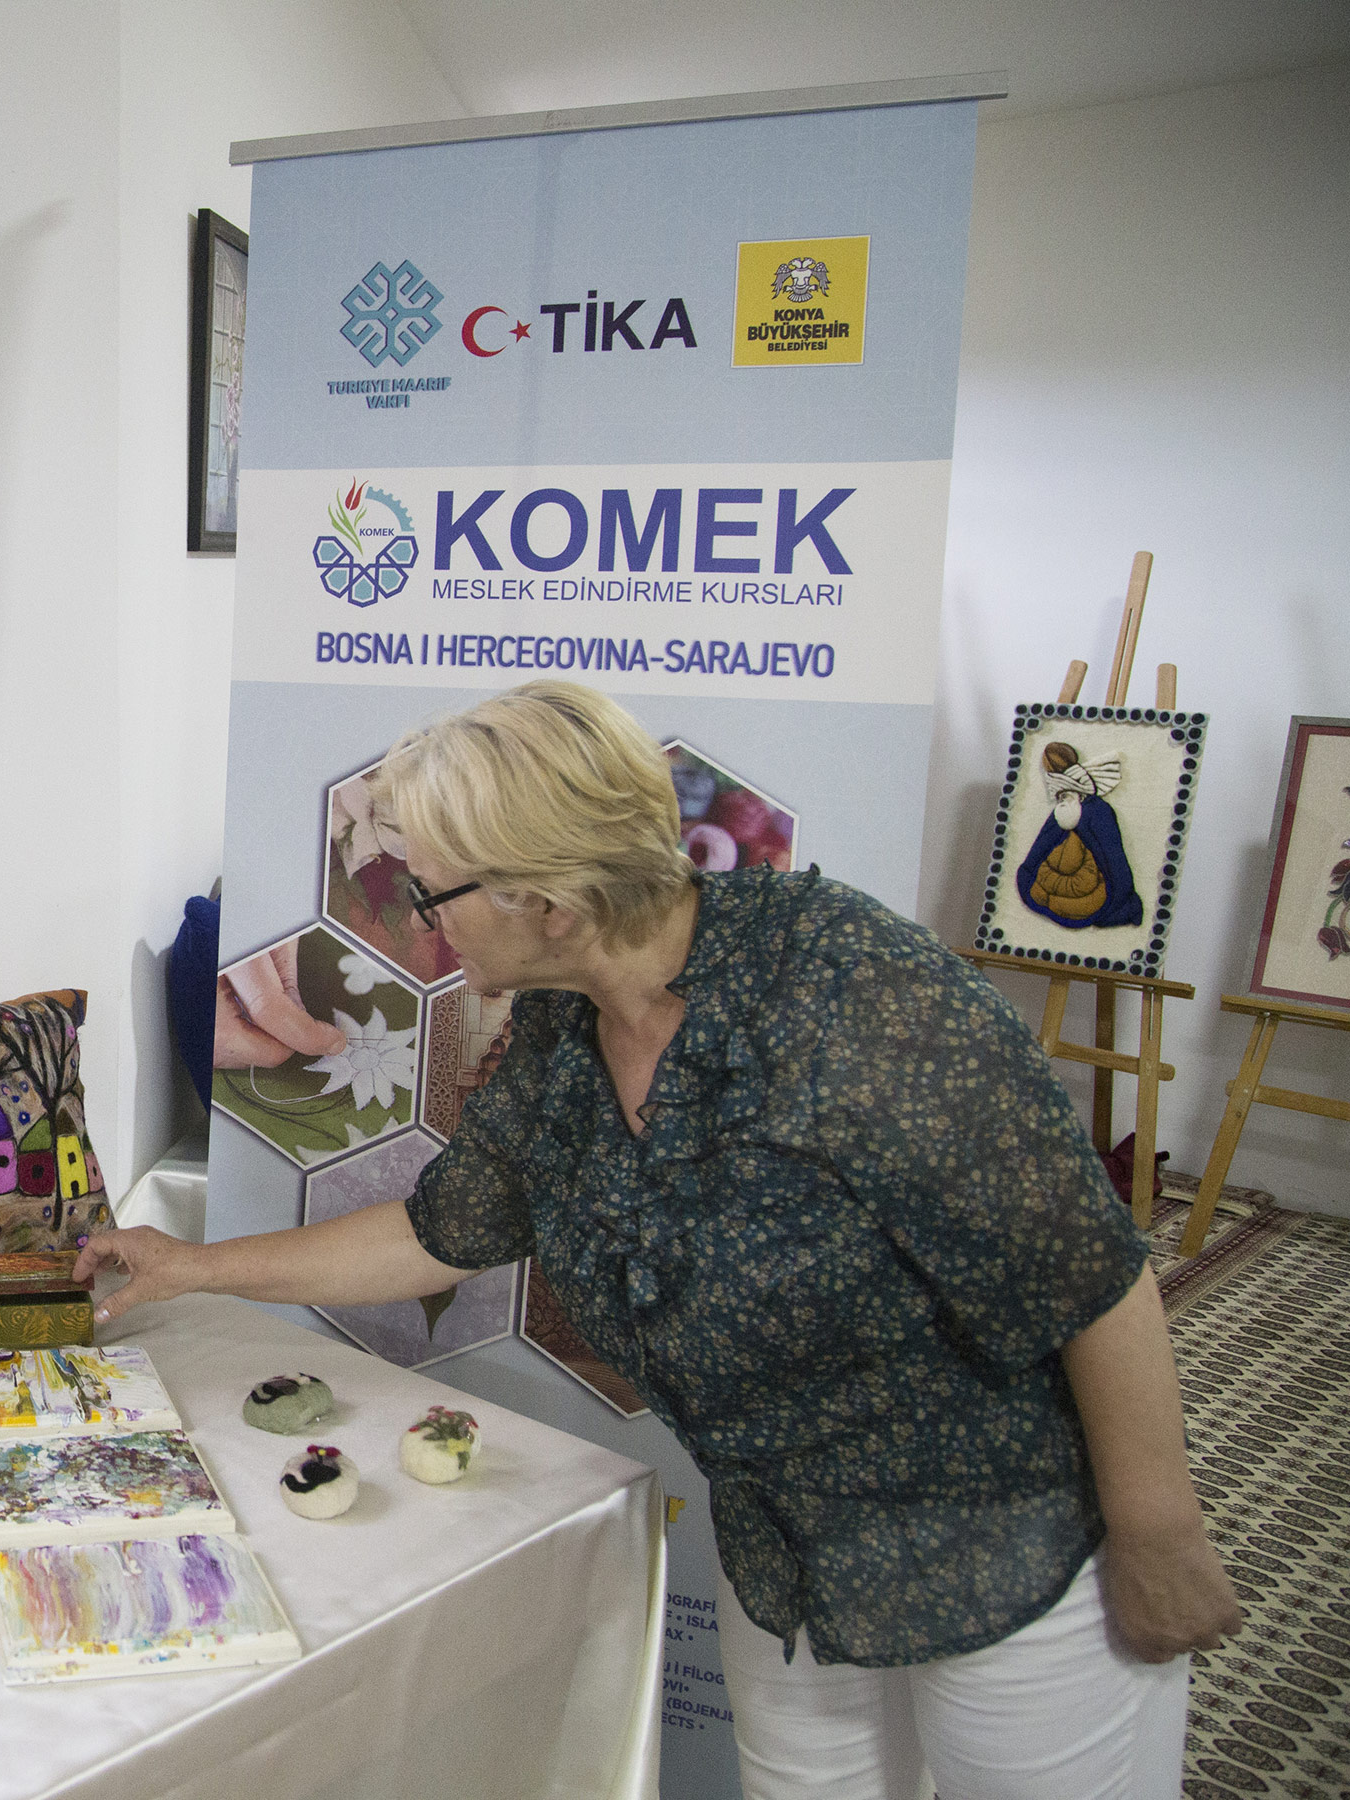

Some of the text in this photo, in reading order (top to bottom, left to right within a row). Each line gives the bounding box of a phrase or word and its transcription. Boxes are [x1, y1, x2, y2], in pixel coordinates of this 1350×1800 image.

[540, 290, 698, 353] TİKA
[774, 308, 825, 321] KONYA
[747, 320, 850, 341] BÜYÜKŞEHİR
[767, 339, 828, 352] BELEDİYESİ
[366, 394, 410, 409] VAKFI
[359, 528, 395, 537] KOMEK
[434, 488, 857, 575] KOMEK
[433, 576, 843, 606] MESLEK EDİNDİRME KURSLARI
[316, 631, 835, 678] BOSNA I HERCEGOVINA-SARAJEVO
